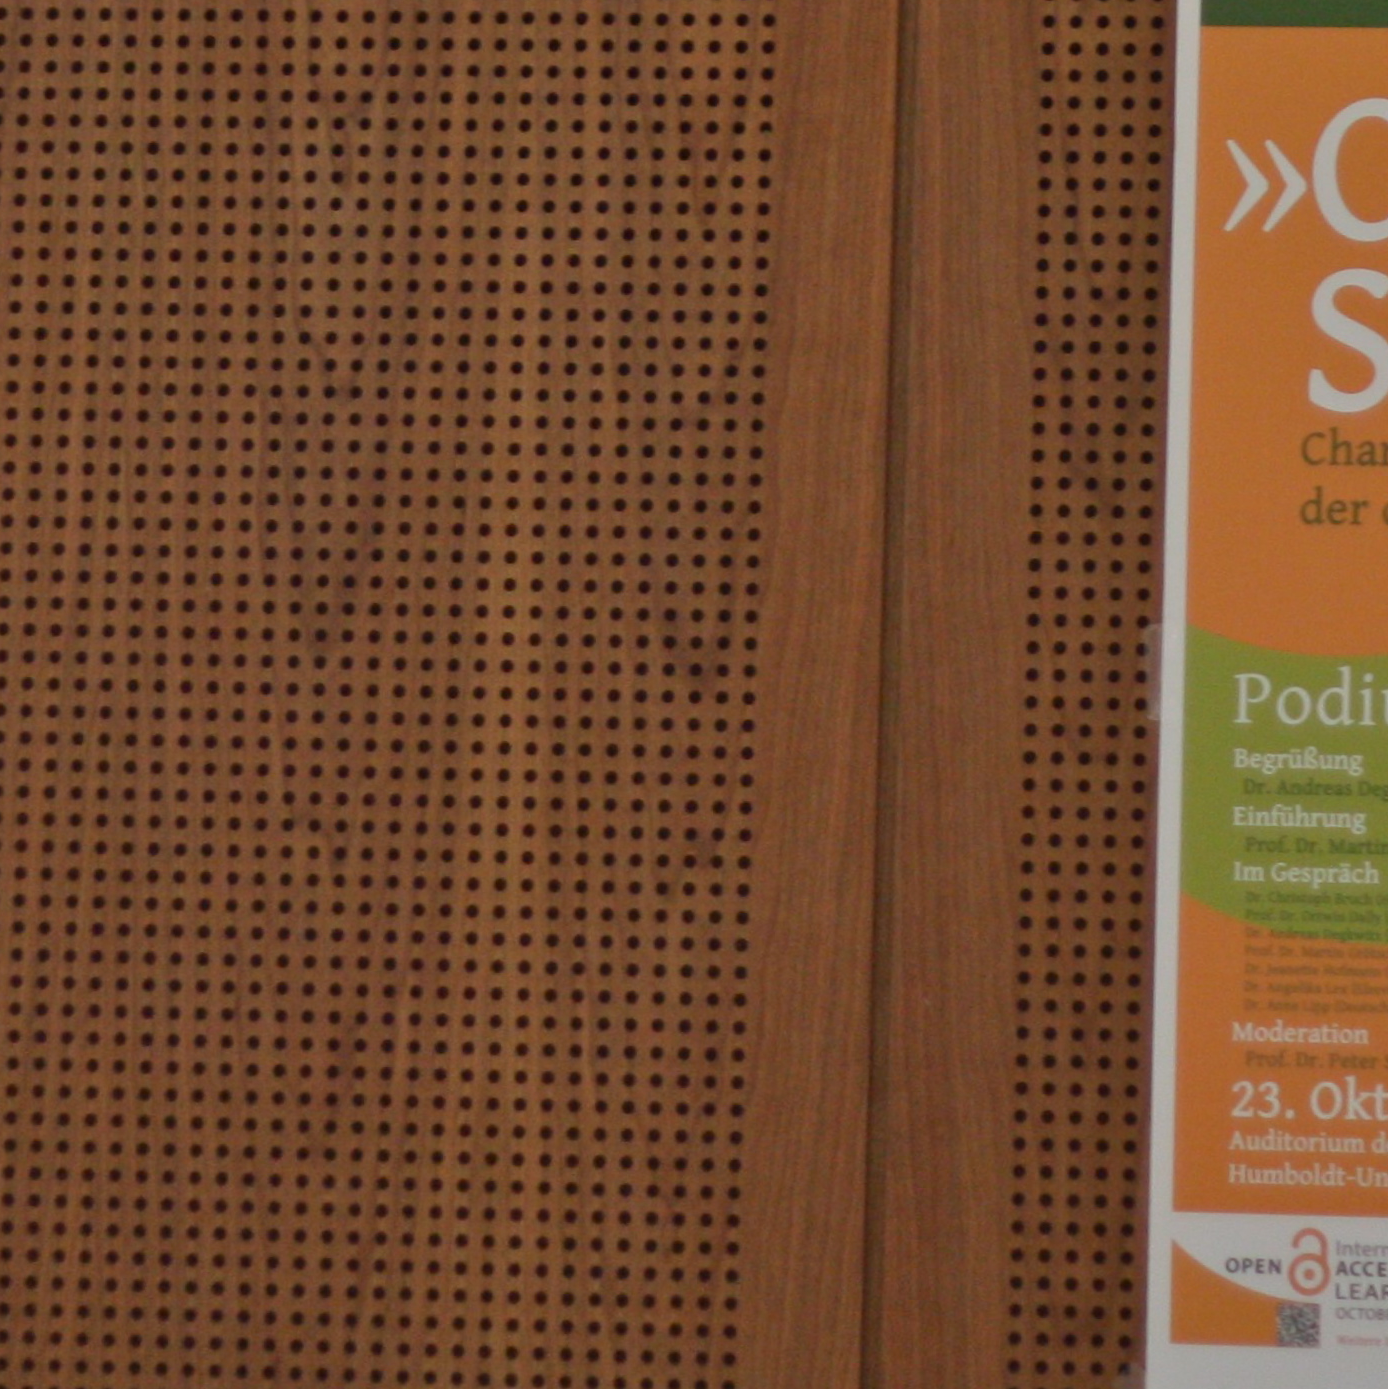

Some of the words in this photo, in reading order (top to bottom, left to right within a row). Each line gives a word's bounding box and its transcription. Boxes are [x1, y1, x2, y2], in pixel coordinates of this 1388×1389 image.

[1299, 487, 1370, 526] der
[1233, 746, 1364, 776] Begrüßung
[1244, 778, 1271, 796] Dr.
[1277, 778, 1352, 797] Andreas
[1233, 804, 1367, 834] Einführung
[1245, 836, 1289, 853] Prof.
[1296, 837, 1320, 854] Dr.
[1233, 862, 1264, 884] Im
[1271, 862, 1380, 889] Gespräch
[1231, 1022, 1369, 1045] Moderation
[1245, 1050, 1292, 1069] Prof.
[1296, 1051, 1324, 1069] Dr.
[1329, 1052, 1378, 1070] Peter
[1231, 1082, 1295, 1120] 23.
[1229, 1131, 1364, 1155] Auditorium
[1225, 1257, 1282, 1275] OPEN
